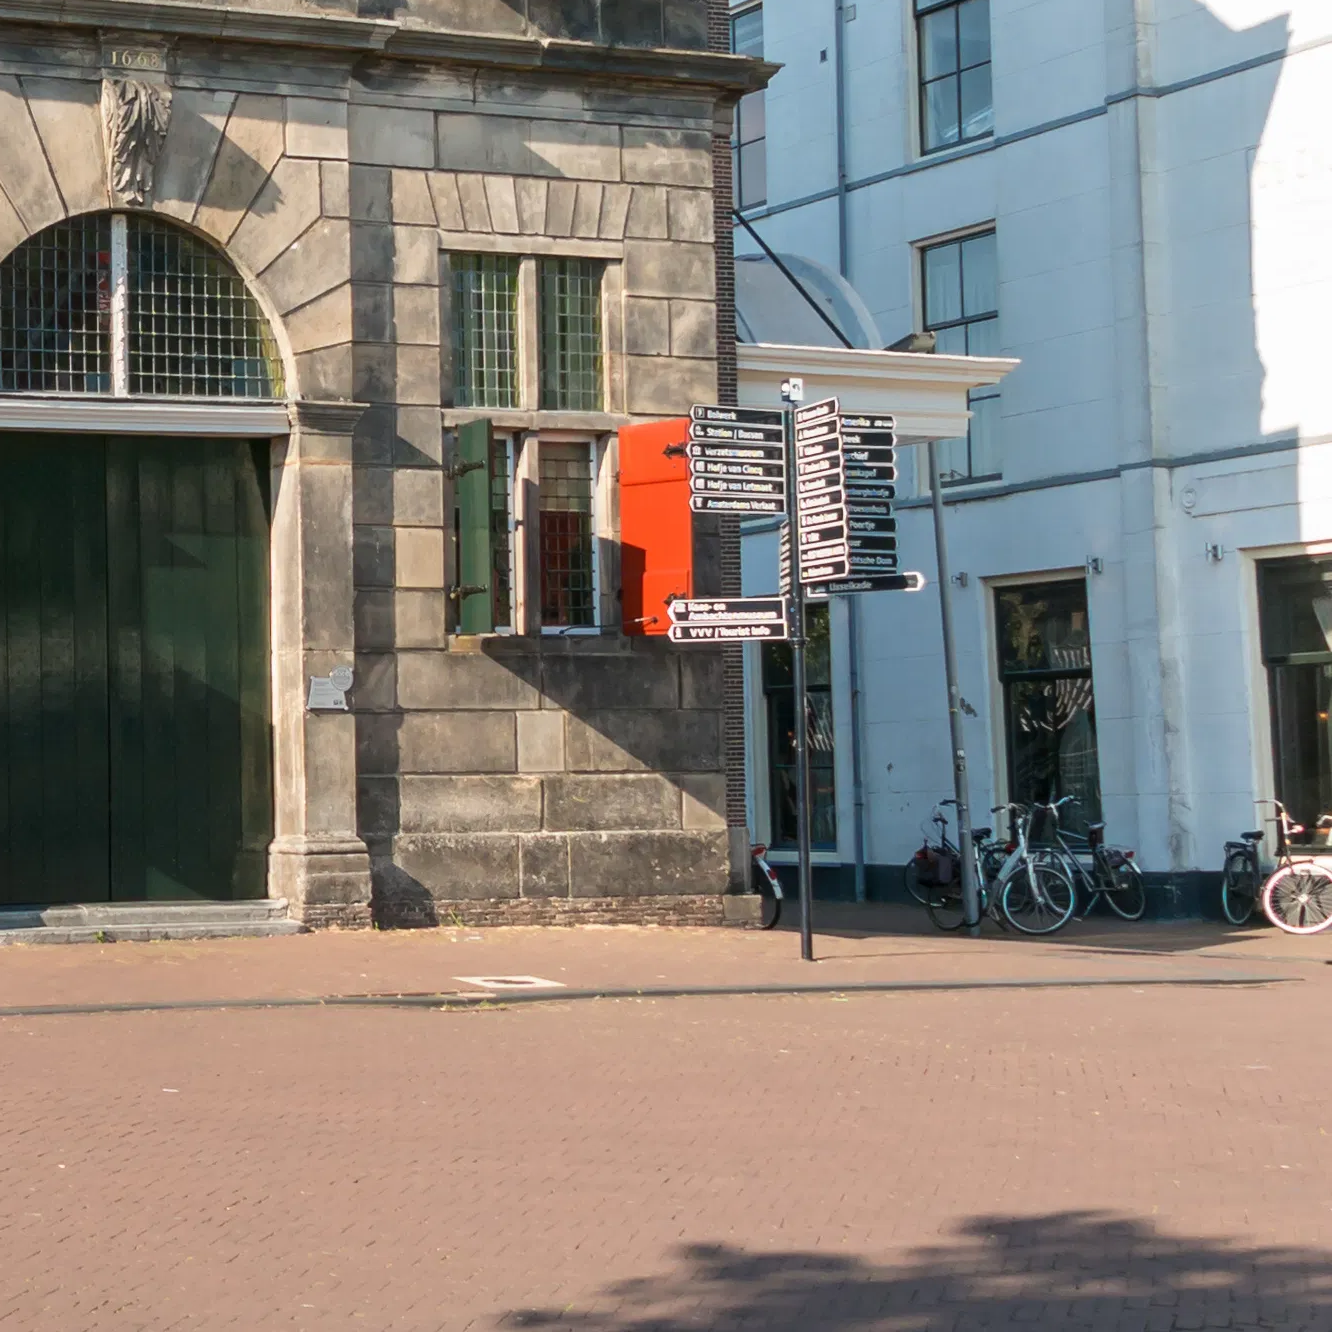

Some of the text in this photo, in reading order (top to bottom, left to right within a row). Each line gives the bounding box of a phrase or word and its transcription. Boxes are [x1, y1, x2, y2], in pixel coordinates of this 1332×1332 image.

[111, 50, 159, 68] 1668
[707, 410, 737, 420] Bolwerk
[706, 427, 733, 437] Station
[705, 447, 765, 458] Verzetsmuseum
[707, 463, 728, 474] Hofje
[707, 480, 728, 492] Hofje
[876, 556, 893, 565] Dom
[713, 603, 726, 611] en
[690, 628, 713, 638] VVV
[719, 627, 751, 637] Tourist
[751, 626, 771, 636] Info
